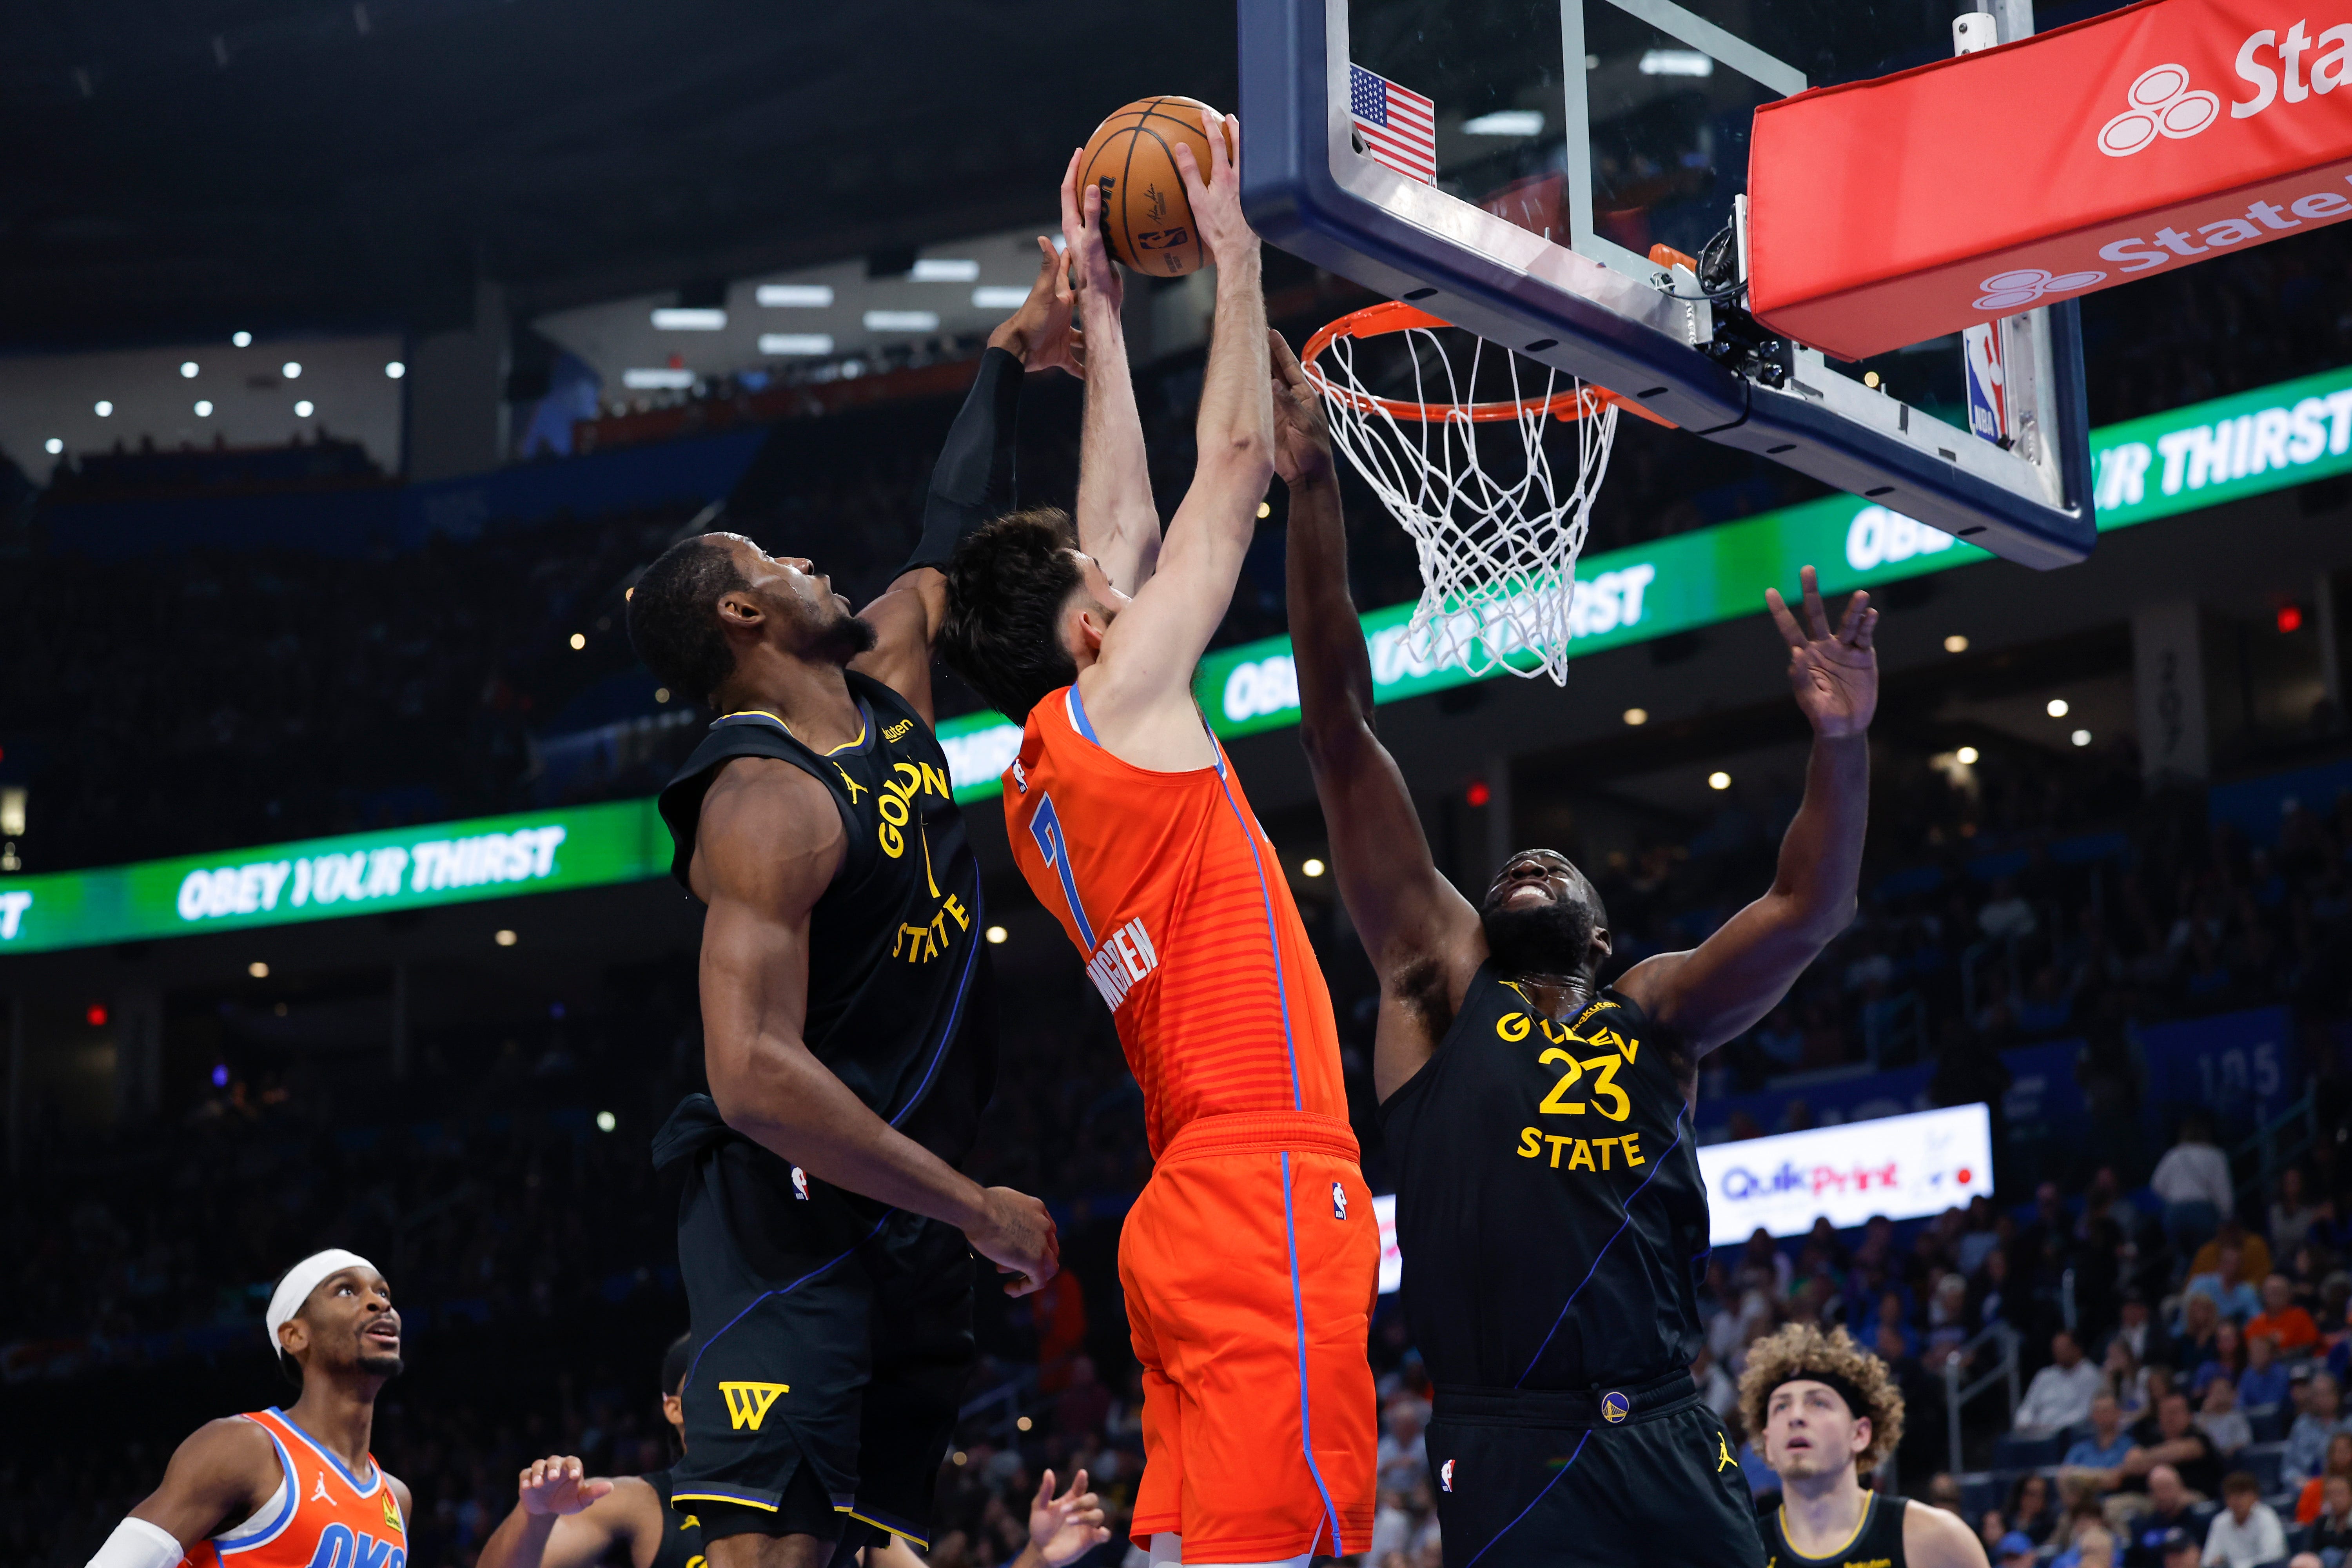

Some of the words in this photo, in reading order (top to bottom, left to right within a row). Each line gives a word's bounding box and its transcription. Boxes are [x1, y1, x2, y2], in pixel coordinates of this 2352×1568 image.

[2098, 175, 2352, 272] State
[1974, 405, 1994, 437] NBA
[2157, 388, 2352, 497] THIRST
[0, 887, 33, 940] T
[176, 862, 292, 921] OBEY
[410, 825, 565, 892] THIRST
[1029, 790, 1097, 954] 7
[1572, 1001, 1621, 1032] Rakuten
[1538, 1047, 1630, 1122] 23
[1517, 1127, 1646, 1172] STATE
